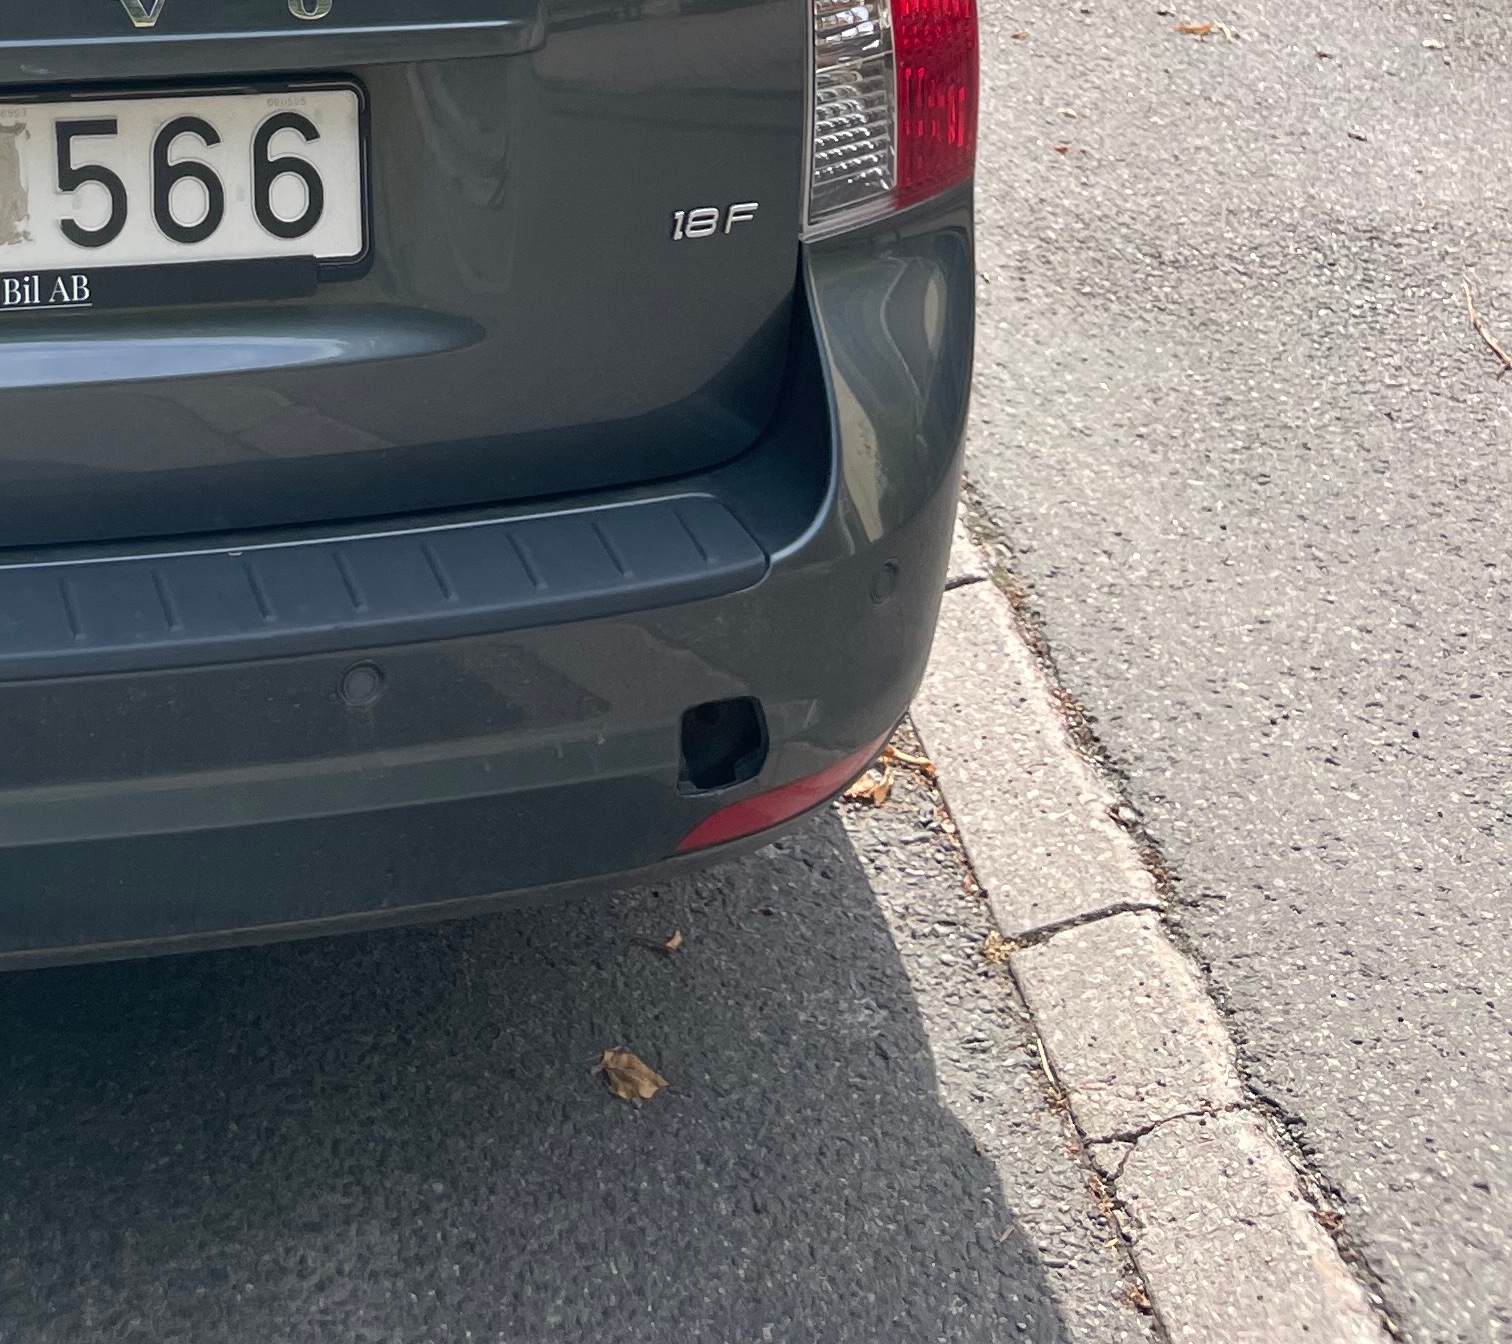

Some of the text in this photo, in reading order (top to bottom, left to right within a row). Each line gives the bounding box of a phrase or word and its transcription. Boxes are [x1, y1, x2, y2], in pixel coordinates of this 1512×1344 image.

[55, 112, 325, 248] 566
[3, 275, 40, 305] Bil
[49, 274, 90, 303] AB
